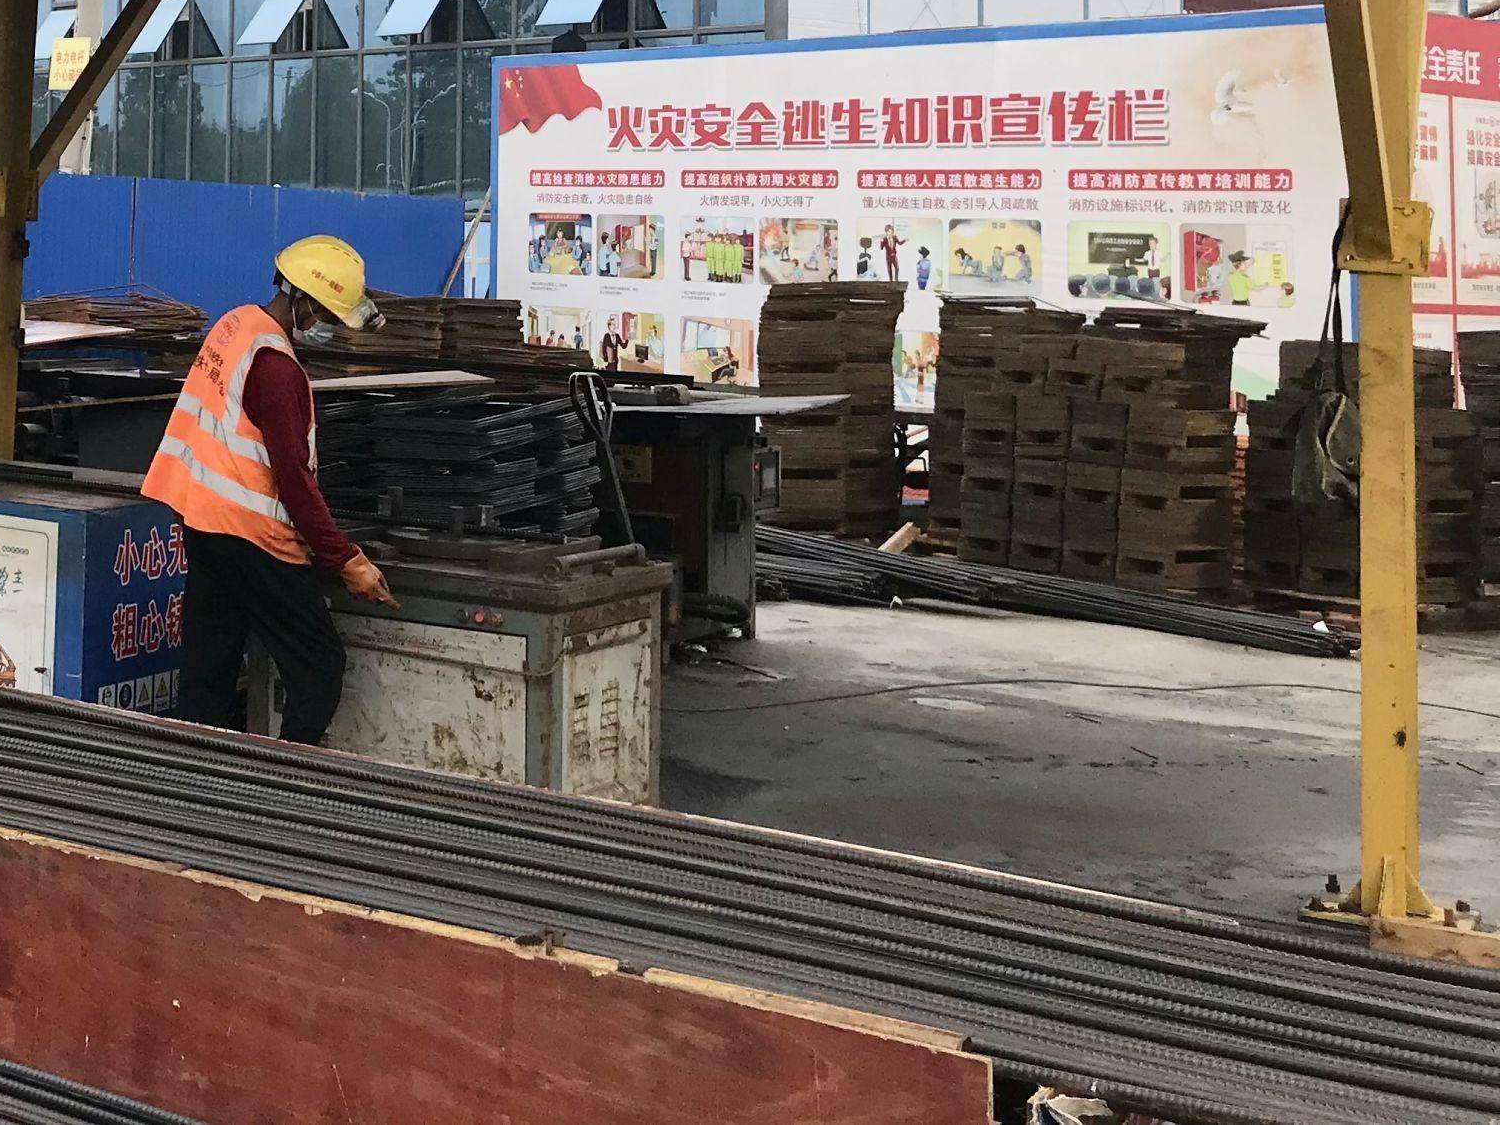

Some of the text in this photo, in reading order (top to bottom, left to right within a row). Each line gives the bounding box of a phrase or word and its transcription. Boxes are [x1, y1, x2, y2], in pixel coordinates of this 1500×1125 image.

[607, 88, 1170, 152] 火灾安全逃生知识宣传栏
[531, 171, 664, 187] 提高检查消除火灾隐患能力
[684, 171, 838, 188] 提高组织扑救初期火灾能力
[860, 172, 1041, 189] 提高组织人员疏散逃生能力
[1072, 172, 1291, 191] 提高消防宣传教育培训能力
[536, 193, 654, 206] 消防安全自查，火灾隐患自除
[699, 194, 815, 208] 火情发现早，小火灭得了
[1068, 198, 1292, 216] 消防设施标识化，消防常识普及化
